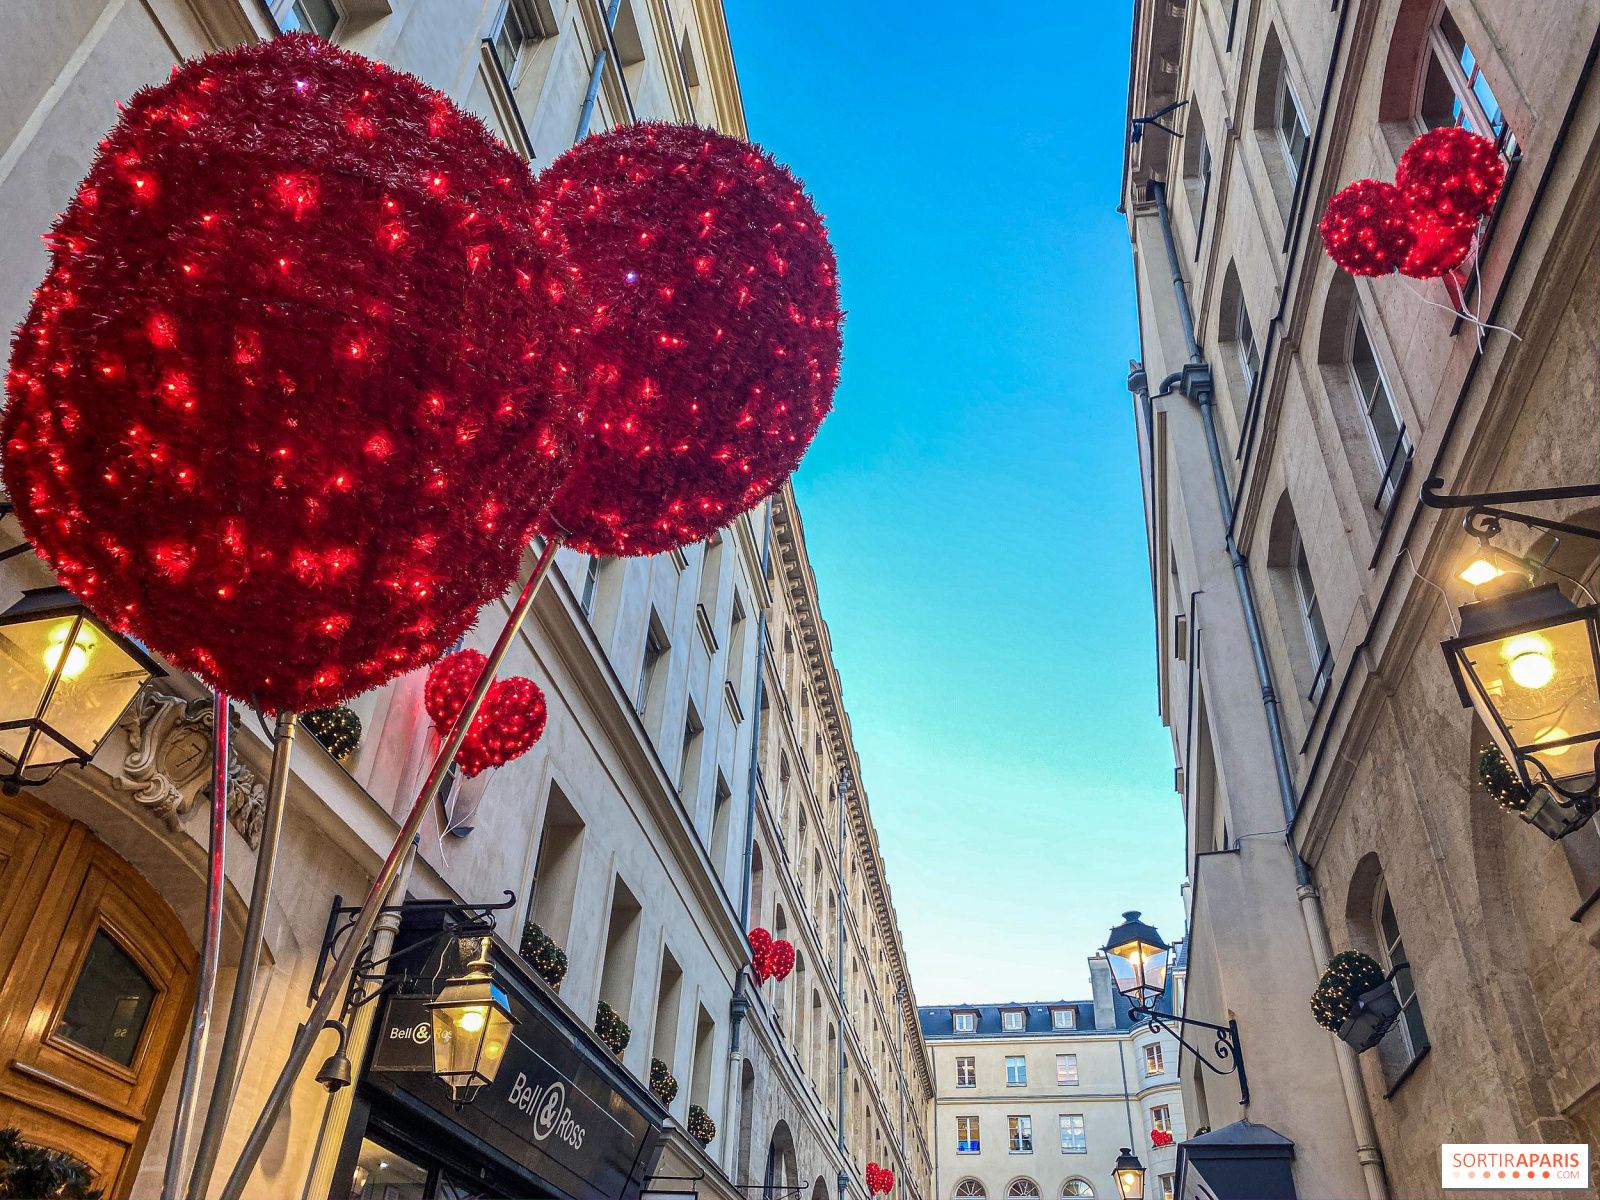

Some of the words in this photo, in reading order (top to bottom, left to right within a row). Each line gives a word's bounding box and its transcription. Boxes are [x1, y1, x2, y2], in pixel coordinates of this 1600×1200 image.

[389, 1027, 413, 1039] Bell
[508, 1072, 543, 1116] Bell
[555, 1107, 586, 1150] Ross
